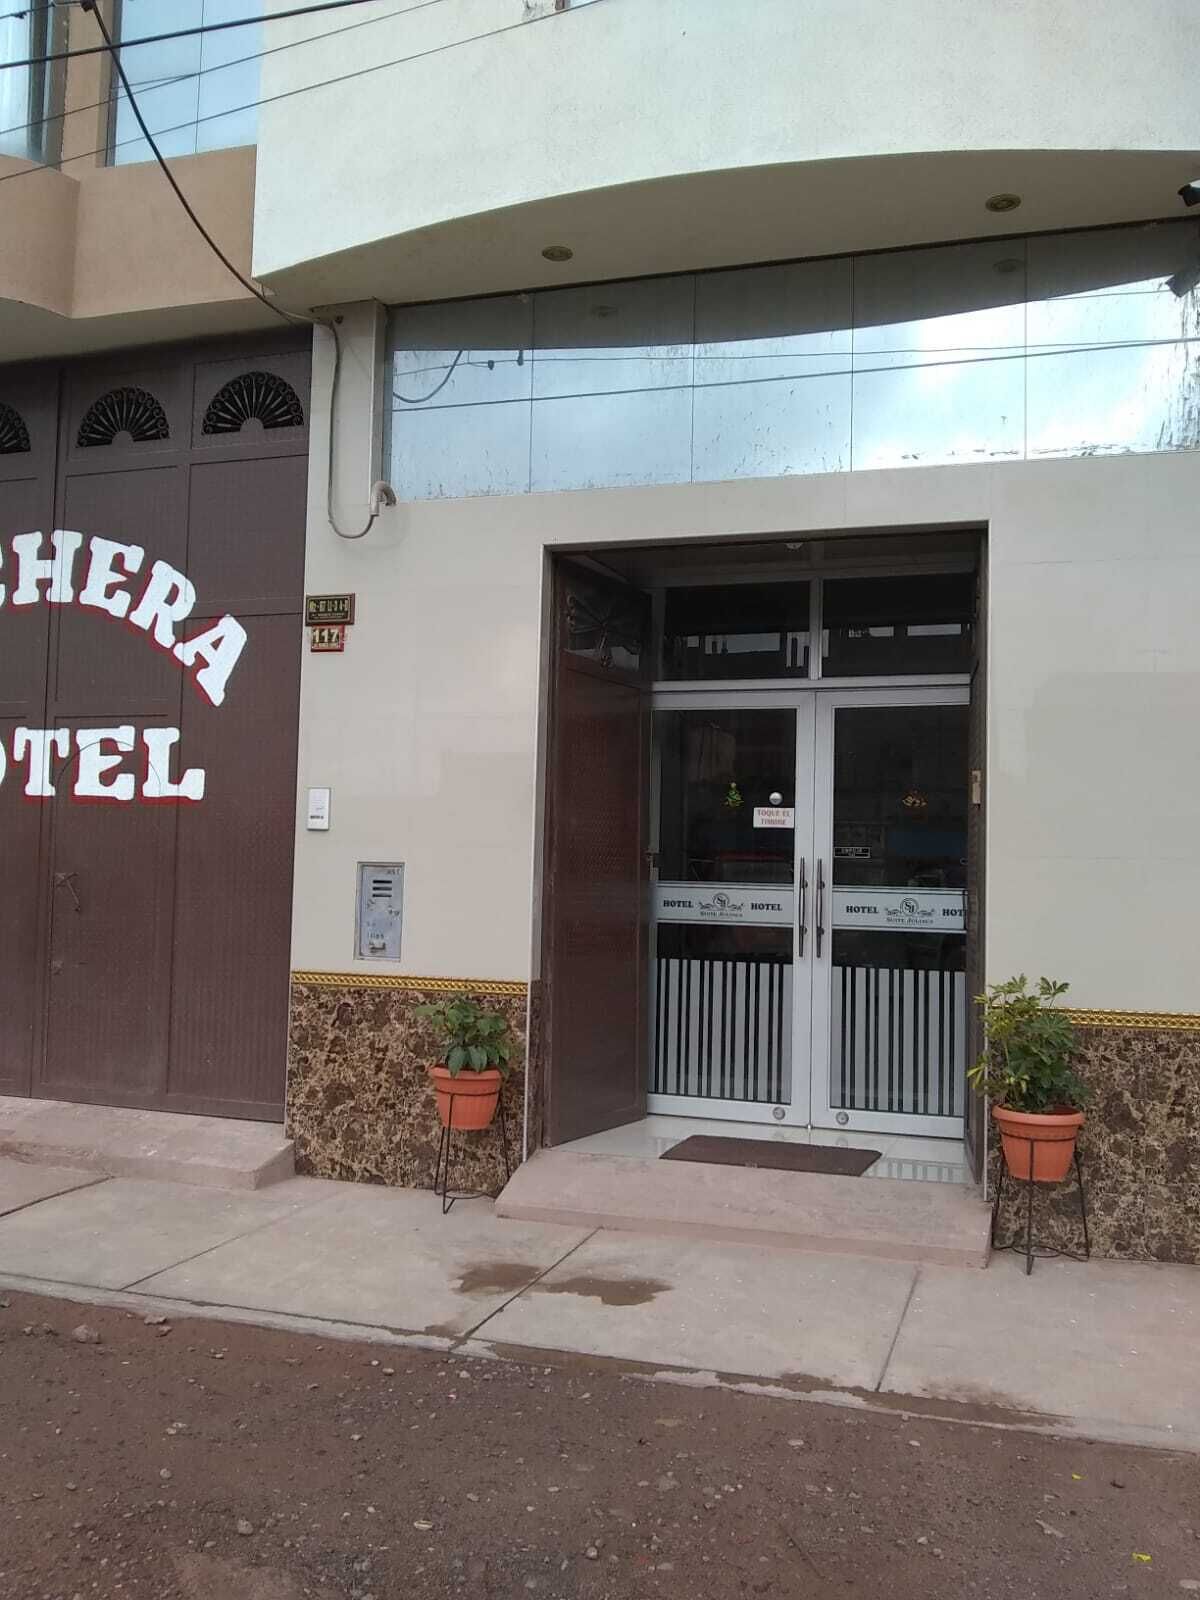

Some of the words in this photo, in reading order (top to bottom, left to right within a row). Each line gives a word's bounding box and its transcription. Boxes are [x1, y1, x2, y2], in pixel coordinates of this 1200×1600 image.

[0, 529, 248, 707] HERA
[312, 629, 340, 643] 117
[0, 725, 206, 803] TEL
[663, 899, 694, 908] HOTEL
[751, 902, 783, 911] HOTEL
[846, 905, 879, 914] HOTEL
